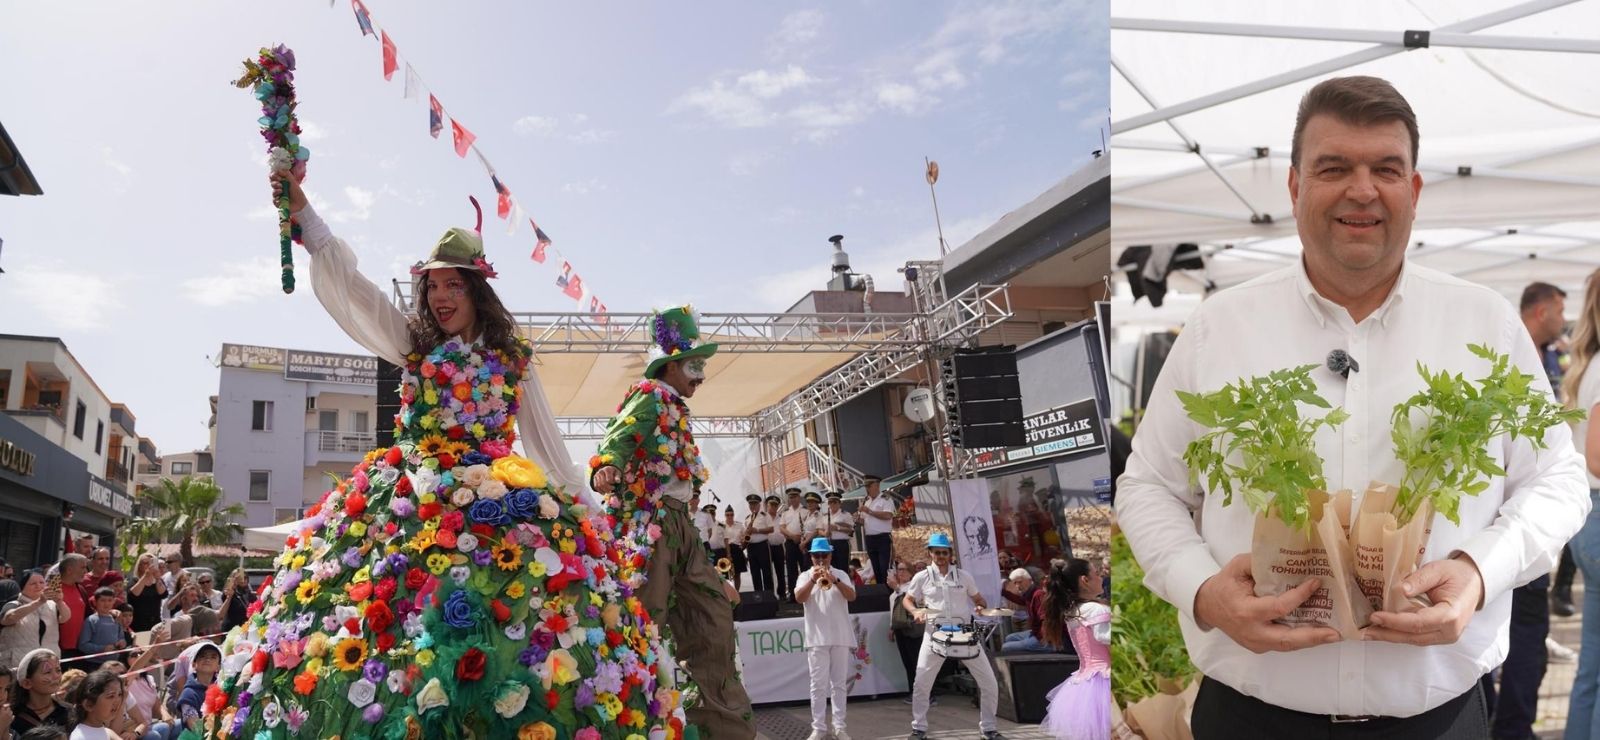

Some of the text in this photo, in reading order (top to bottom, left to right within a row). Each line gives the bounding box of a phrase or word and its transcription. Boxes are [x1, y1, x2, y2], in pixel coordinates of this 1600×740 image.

[290, 353, 340, 367] MARTI
[1035, 438, 1075, 454] SIEMENS
[1271, 565, 1307, 575] TOHUM
